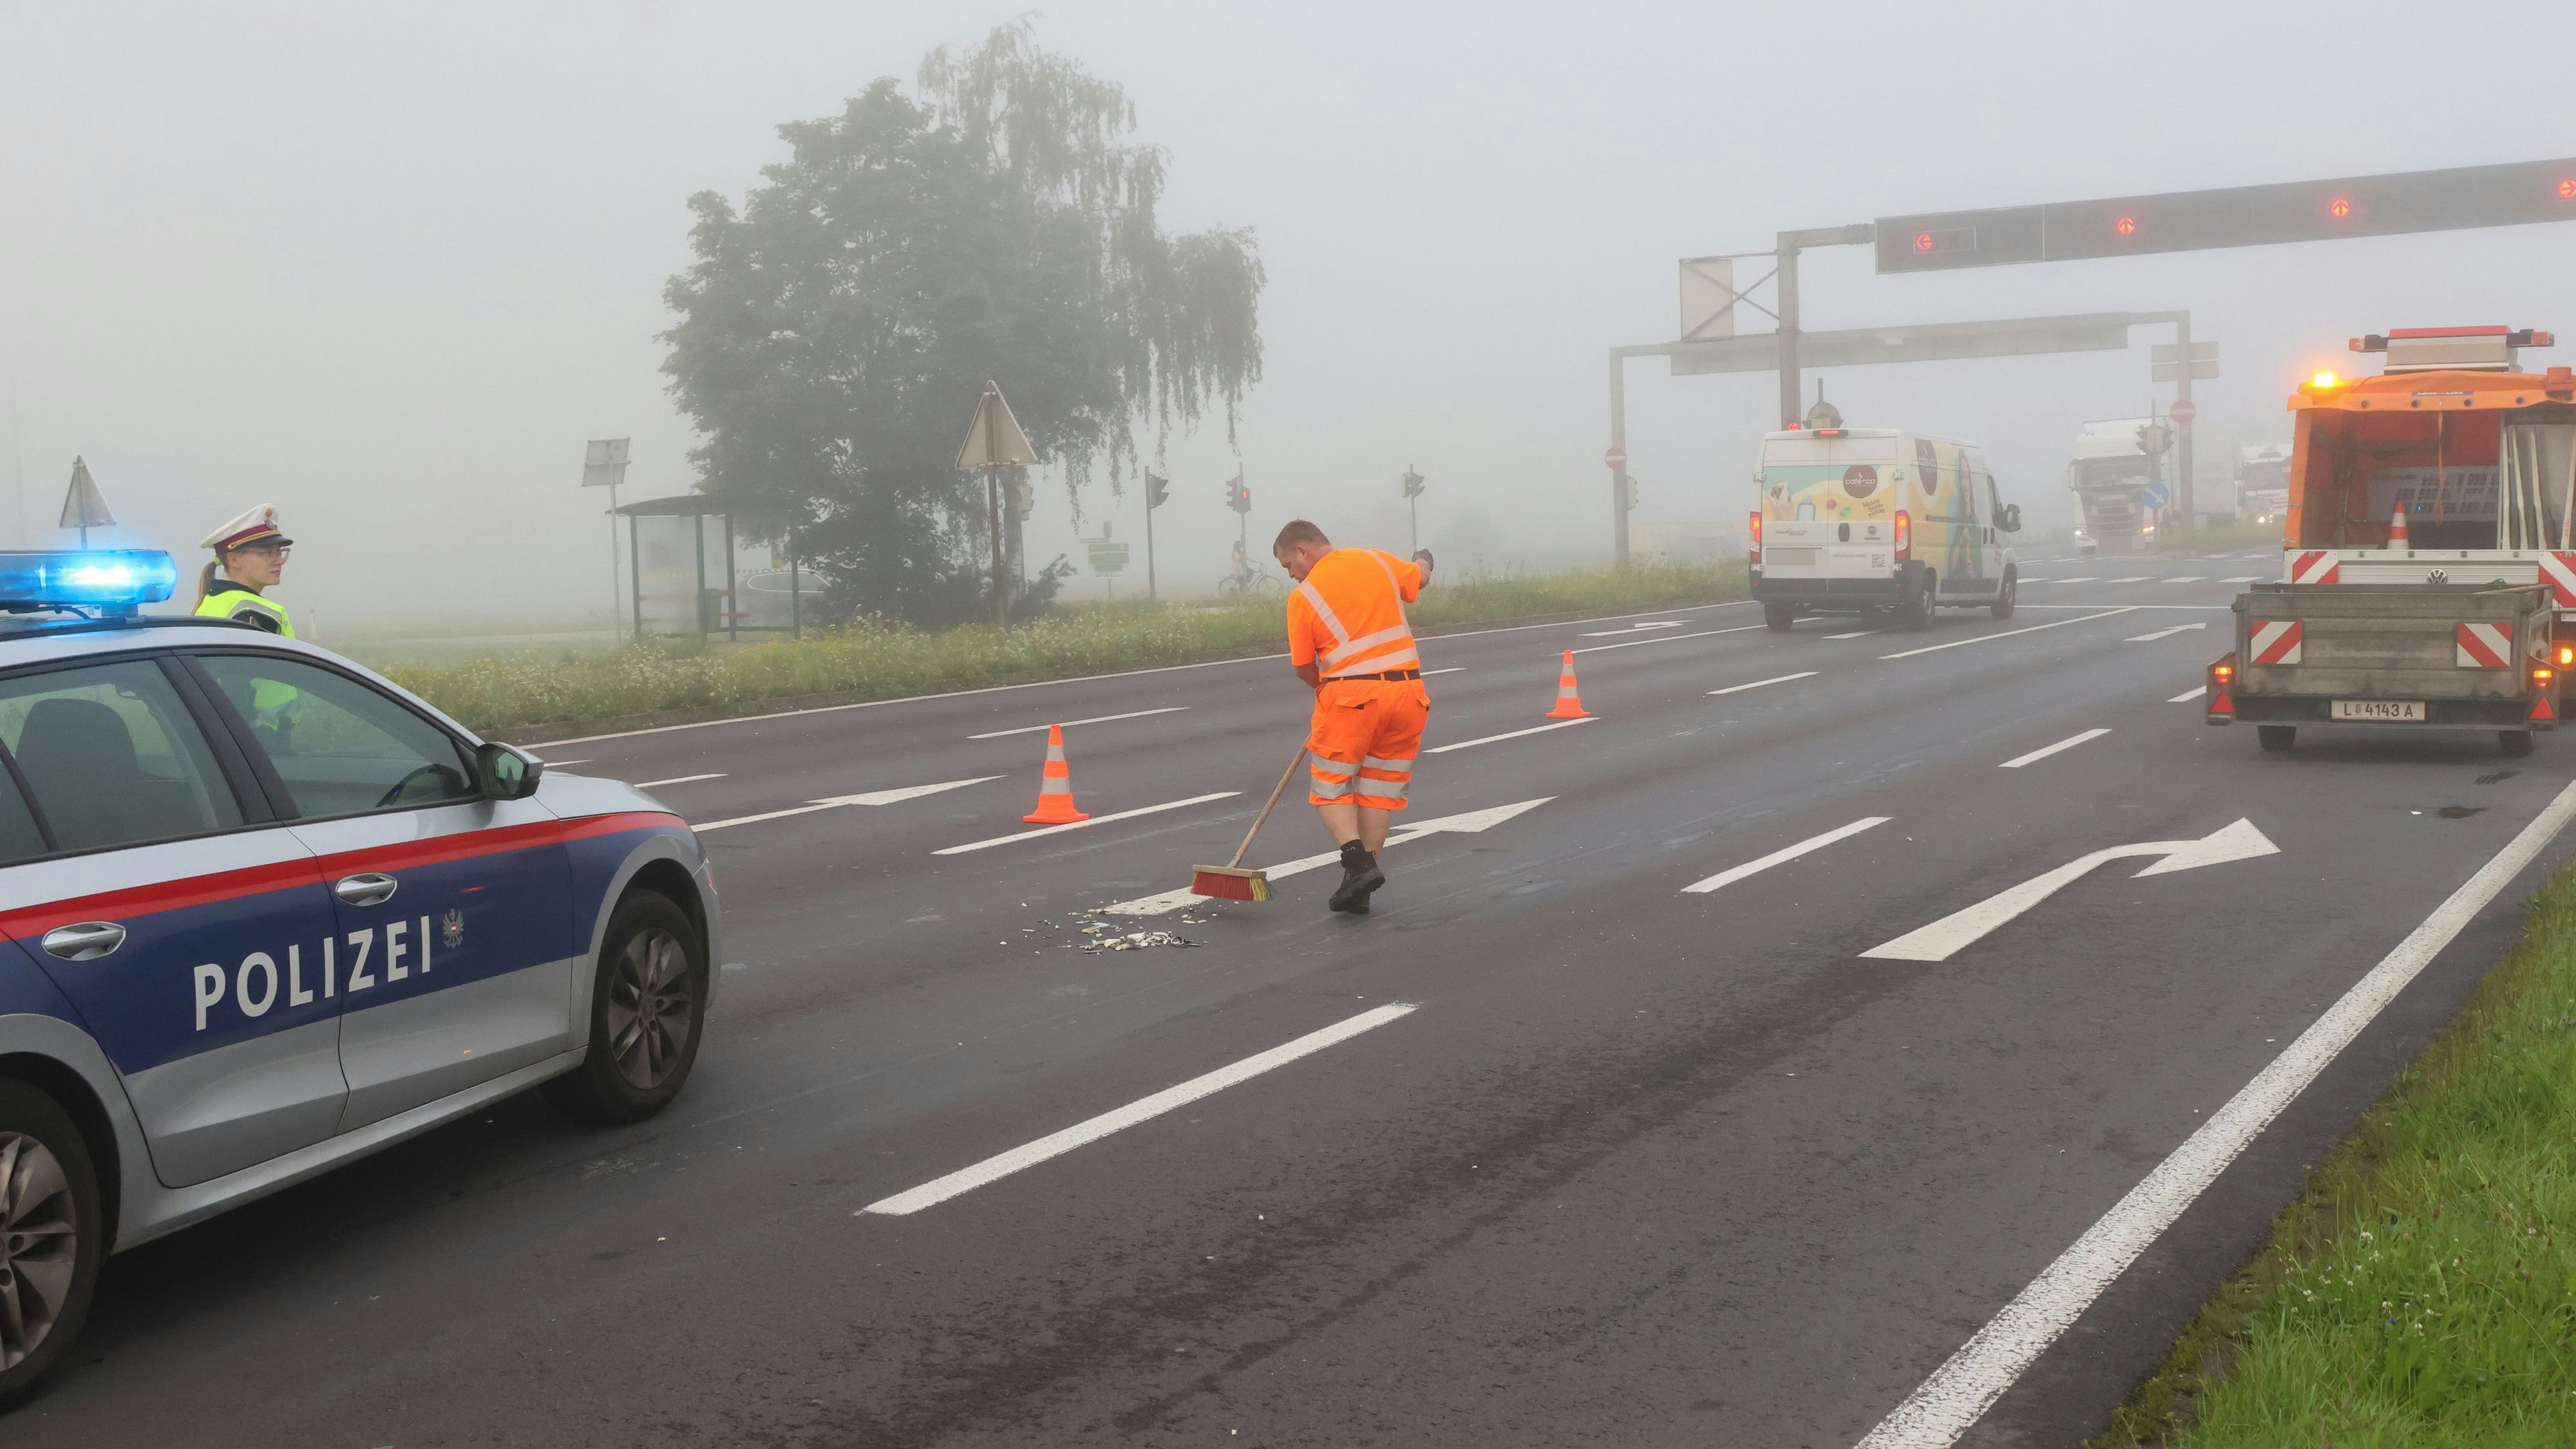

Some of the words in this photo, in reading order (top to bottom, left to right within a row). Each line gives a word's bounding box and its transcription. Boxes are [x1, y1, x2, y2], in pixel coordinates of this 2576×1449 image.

[2344, 703, 2352, 716] L
[2365, 703, 2400, 717] 4143
[2404, 704, 2414, 717] A
[194, 915, 431, 1031] POLIZEI
